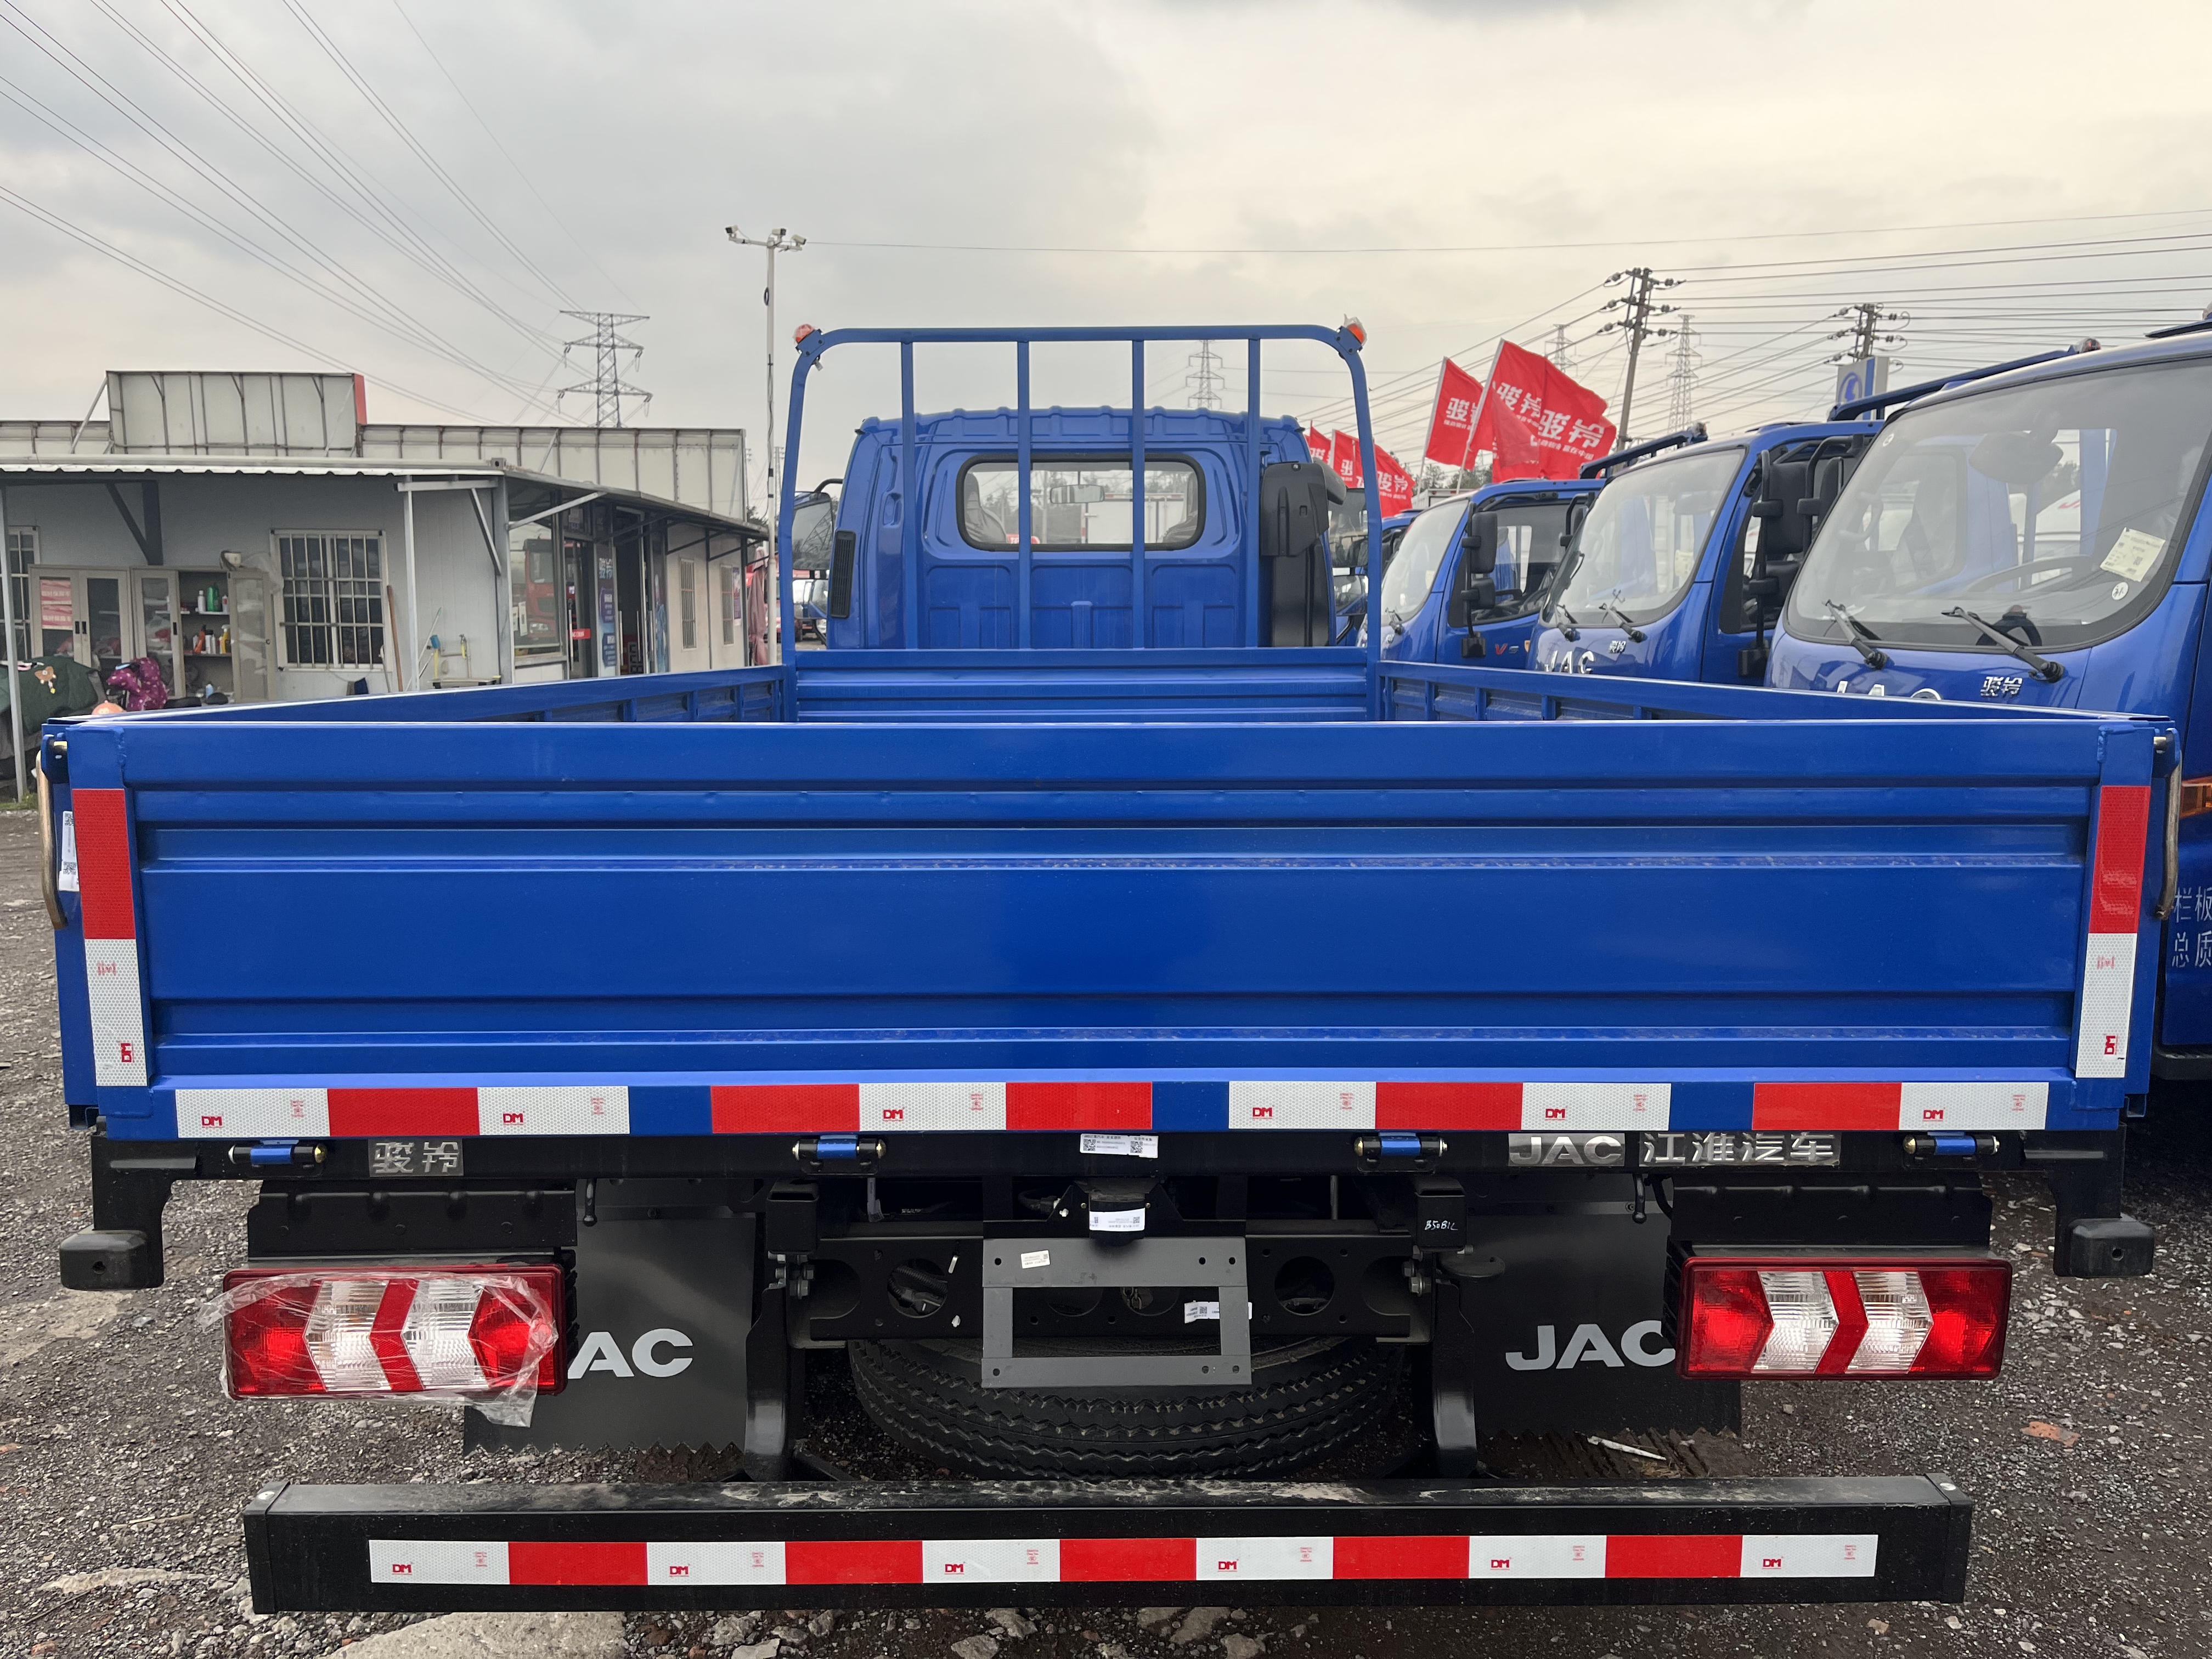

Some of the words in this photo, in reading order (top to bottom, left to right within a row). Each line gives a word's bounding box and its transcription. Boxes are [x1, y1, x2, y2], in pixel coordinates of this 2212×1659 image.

[1538, 409, 1605, 448] 骏铃
[1544, 650, 1595, 674] JAC
[2173, 885, 2212, 923] 栏板
[2171, 930, 2212, 968] 总质
[2106, 1036, 2115, 1054] DM
[122, 1043, 131, 1062] DM
[883, 1110, 904, 1119] DM
[1253, 1107, 1272, 1117] DM
[1547, 1109, 1565, 1118] DM
[1923, 1110, 1944, 1119] DM
[201, 1116, 222, 1126] DM
[503, 1113, 523, 1123] DM
[1510, 1136, 1623, 1164] JAC
[1644, 1132, 1835, 1163] 江淮汽车
[373, 1142, 459, 1173] 骏铃
[1506, 1320, 1675, 1370] JAC
[568, 1328, 693, 1379] AC
[945, 1564, 963, 1572] DM
[1218, 1561, 1237, 1570] DM
[1491, 1560, 1509, 1568] DM
[1763, 1559, 1781, 1567] DM
[670, 1566, 689, 1575] DM
